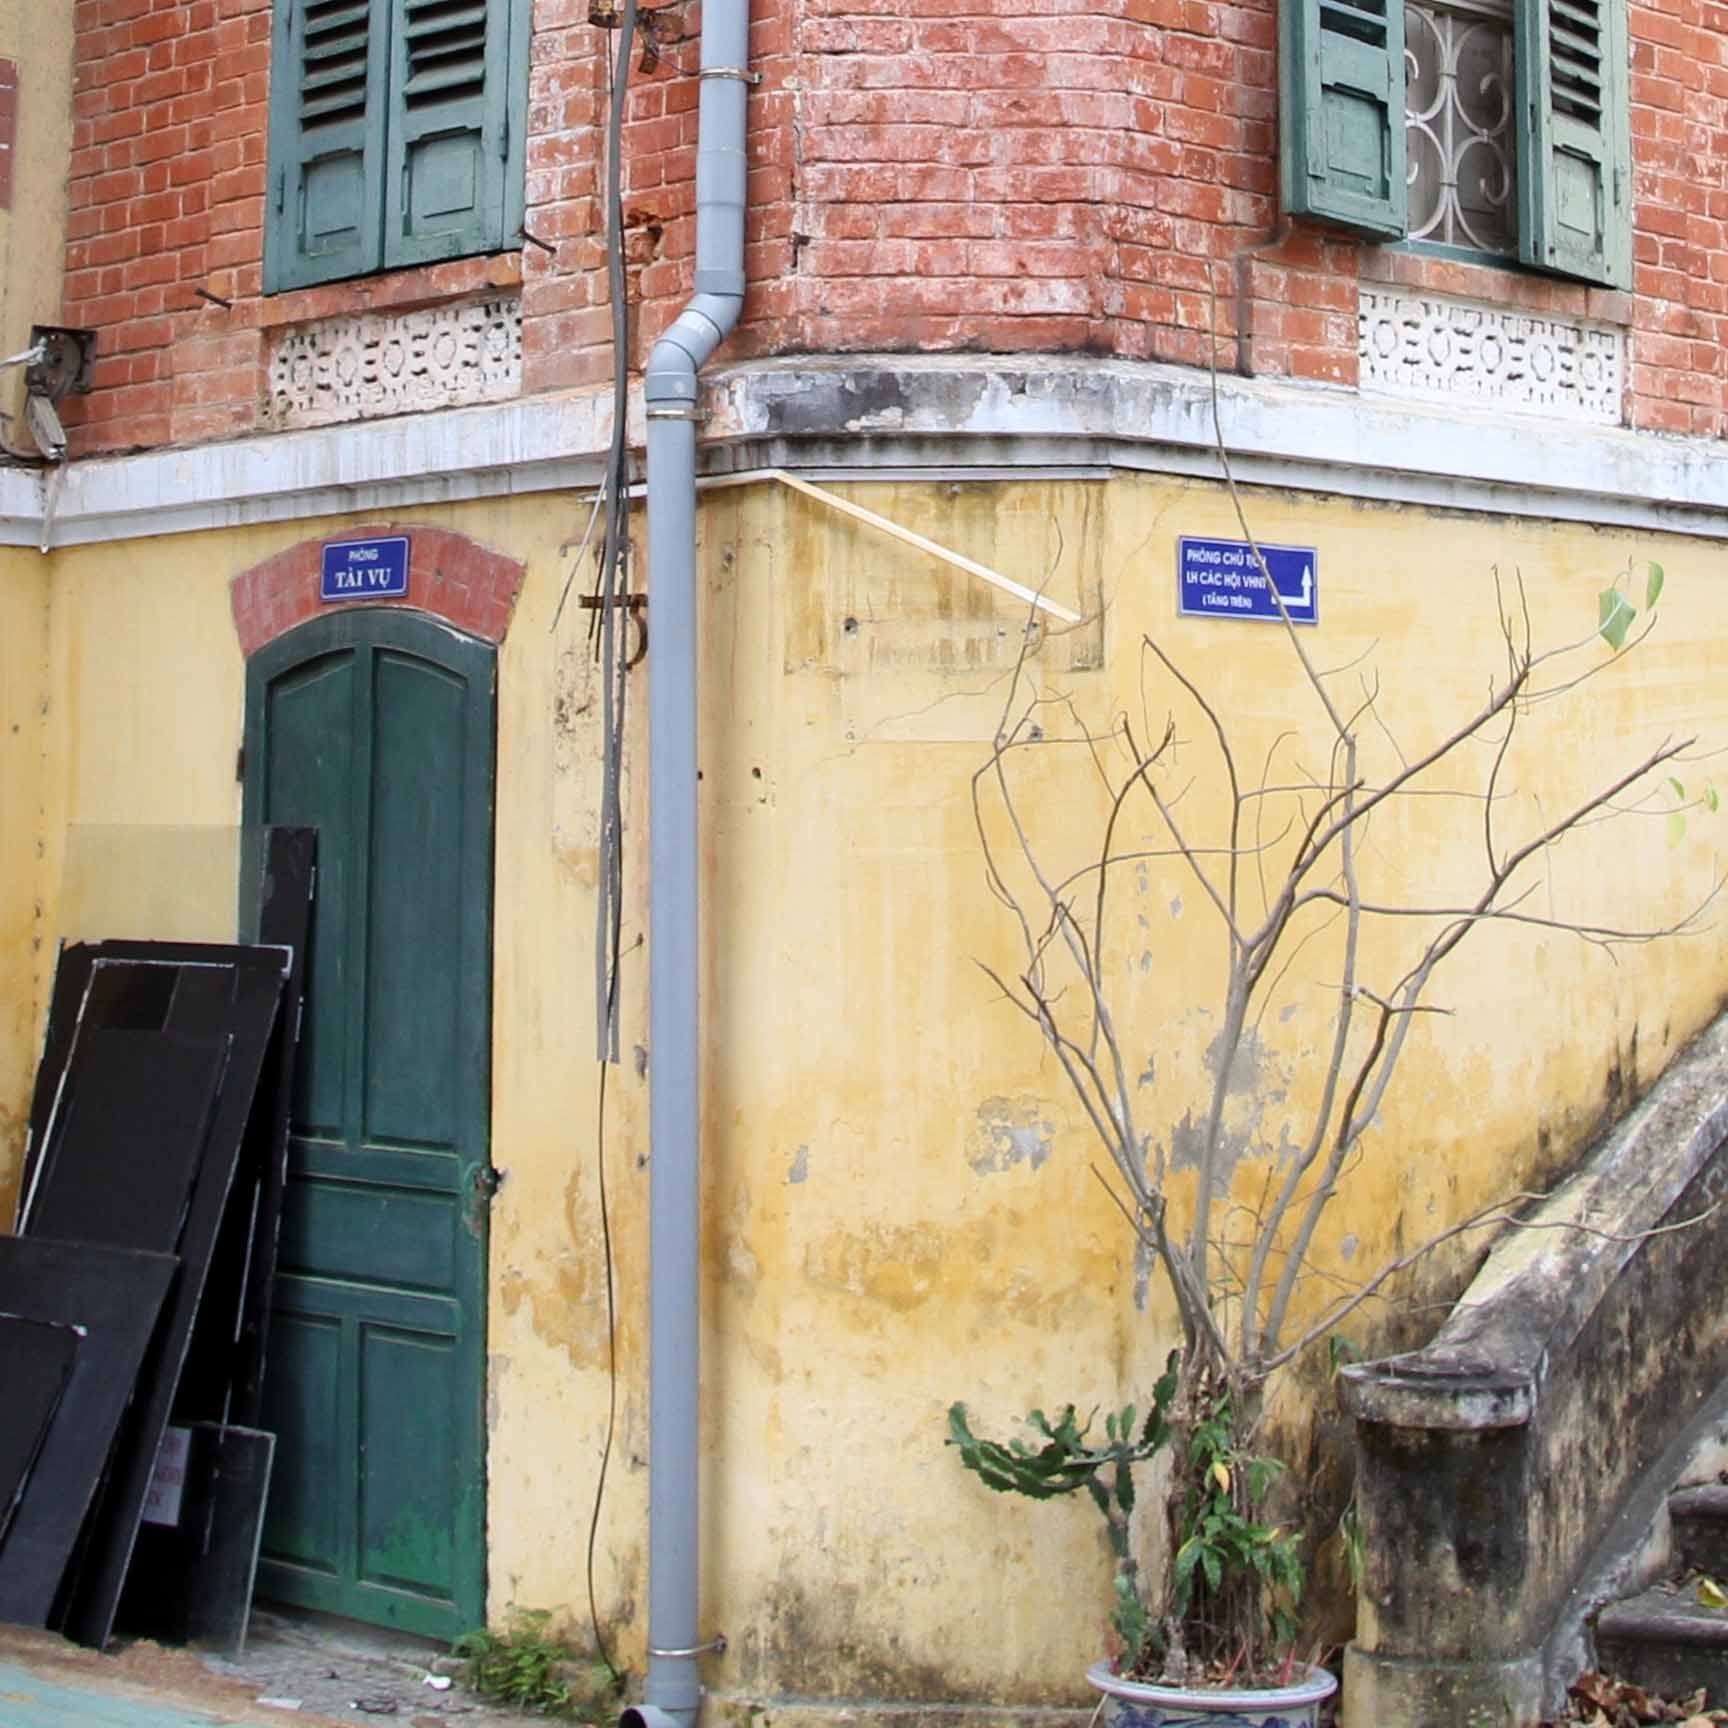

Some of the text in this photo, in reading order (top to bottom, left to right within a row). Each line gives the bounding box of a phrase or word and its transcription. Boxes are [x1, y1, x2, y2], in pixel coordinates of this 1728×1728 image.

[348, 547, 379, 562] PHÒNG
[1187, 547, 1221, 564] PHÒNG
[1222, 548, 1244, 567] CHỦ
[335, 566, 392, 589] TÀI VỤ
[1186, 570, 1198, 584] LH
[1200, 569, 1222, 586] CÁC
[1224, 571, 1241, 590] HỘI
